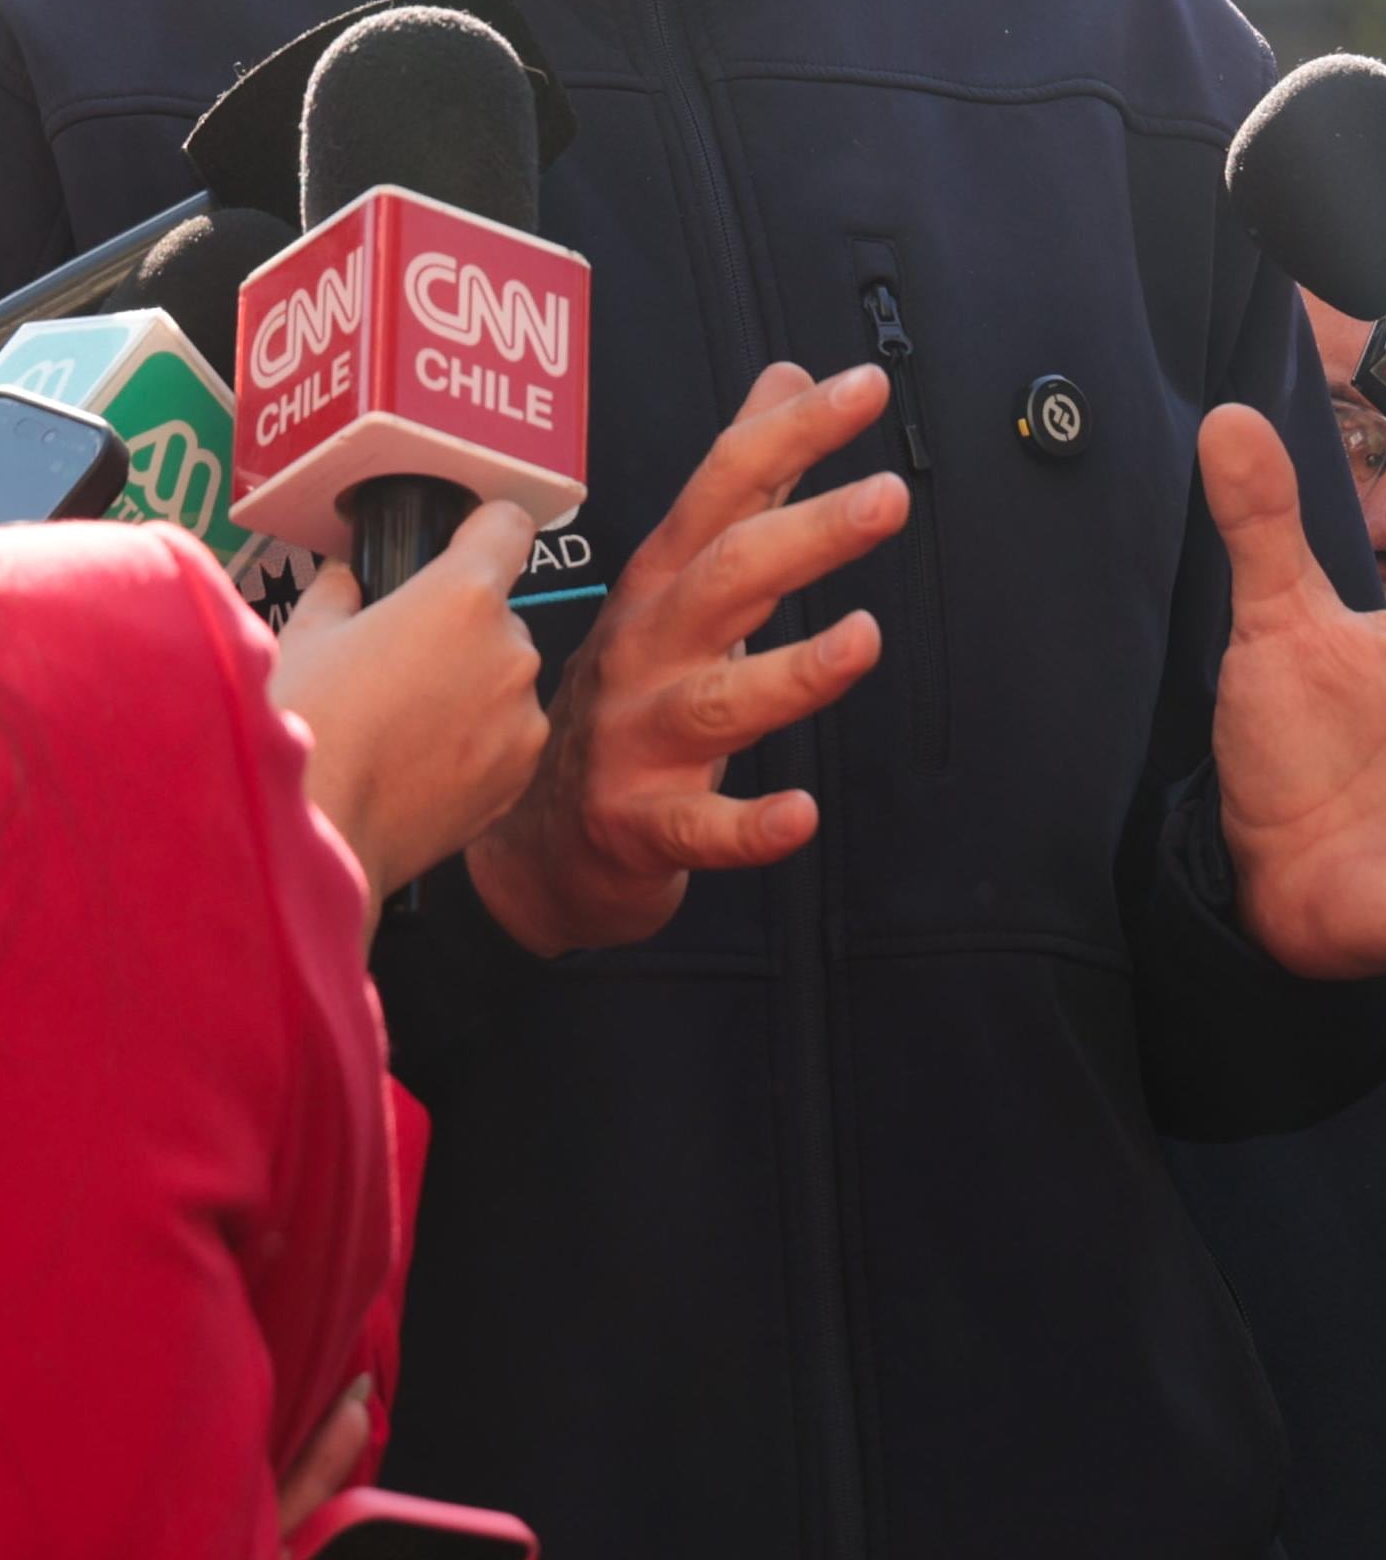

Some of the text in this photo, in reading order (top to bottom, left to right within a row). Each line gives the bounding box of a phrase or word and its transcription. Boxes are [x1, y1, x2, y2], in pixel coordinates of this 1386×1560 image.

[250, 246, 364, 389] CNN
[404, 252, 569, 377] CNN
[256, 351, 352, 447] CHILE
[415, 348, 554, 430] CHILE
[520, 534, 592, 574] AD
